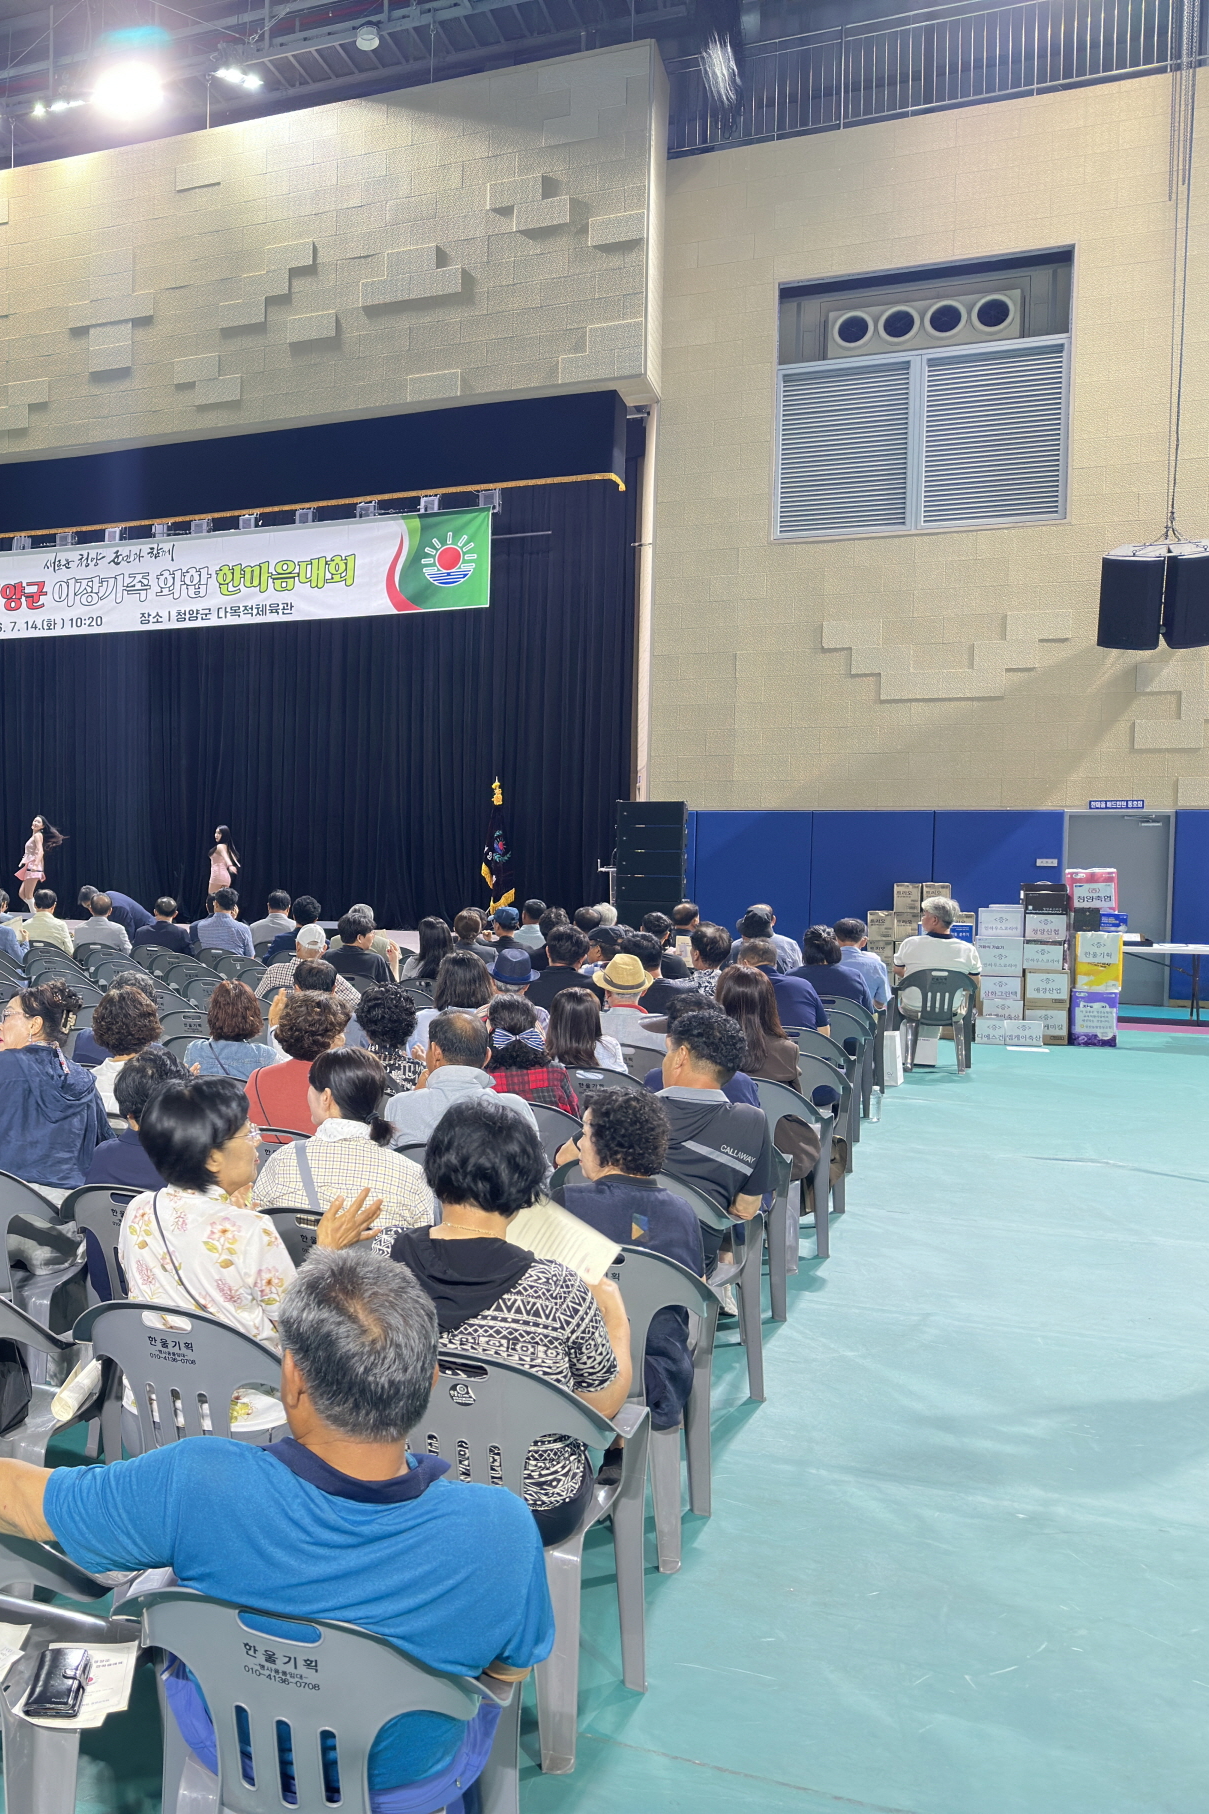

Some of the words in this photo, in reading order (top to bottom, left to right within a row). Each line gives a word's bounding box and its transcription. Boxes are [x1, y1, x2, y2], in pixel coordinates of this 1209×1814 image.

[43, 552, 75, 573] 새로운
[76, 551, 106, 568] 청양
[108, 549, 145, 565] 군민과
[147, 543, 175, 562] 함께
[52, 572, 151, 607] 이장가족
[155, 566, 211, 600] 화합
[216, 553, 356, 596] 한마음대회
[10, 621, 21, 632] 7.
[69, 615, 103, 629] 10:20
[140, 611, 163, 625] 장소
[176, 608, 212, 622] 청양군
[217, 602, 294, 619] 다목적체육관
[720, 1144, 756, 1164] CALLAWAY
[147, 1336, 194, 1352] 한울기획
[242, 1642, 318, 1673] 한울기획
[244, 1665, 320, 1691] 010-4136-0708
